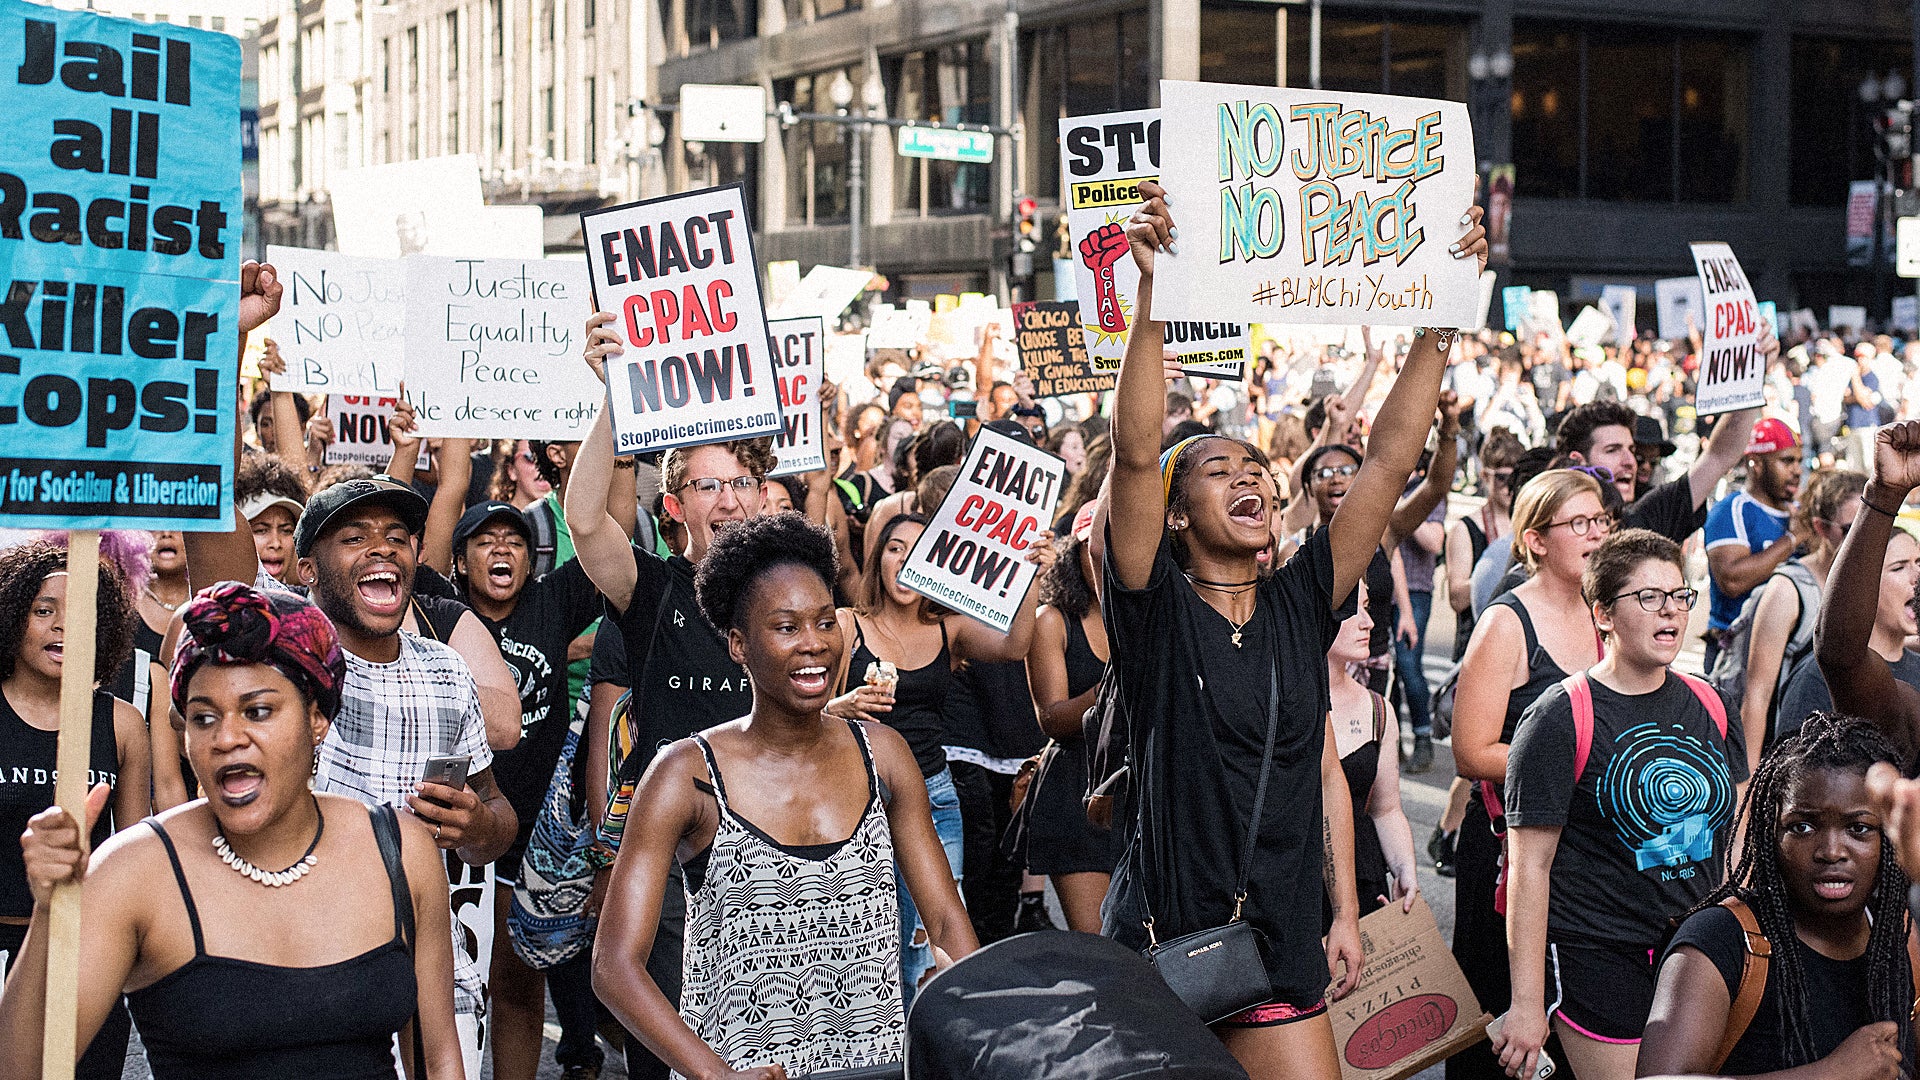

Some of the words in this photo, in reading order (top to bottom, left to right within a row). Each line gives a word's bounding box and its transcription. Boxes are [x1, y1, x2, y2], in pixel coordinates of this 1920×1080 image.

[17, 18, 191, 107] Jail
[50, 107, 160, 179] all
[1066, 118, 1161, 177] ST
[1217, 99, 1285, 183] NO
[1290, 102, 1445, 184] JUSTICE
[1077, 183, 1140, 204] Police
[1219, 181, 1286, 265] NO
[1299, 178, 1426, 268] PEACE
[600, 209, 735, 287] ENACT
[292, 269, 343, 306] No
[448, 260, 568, 300] Justice
[1252, 273, 1433, 311] #BLMChiYouth
[1702, 258, 1746, 294] ENACT
[622, 279, 738, 348] CPAC
[1024, 310, 1070, 330] CHICAGO
[1163, 321, 1242, 345] OUNCIL
[1715, 299, 1756, 340] CPAC
[460, 349, 540, 384] Peace
[770, 331, 816, 369] ACT
[1022, 348, 1064, 368] KILLING
[1068, 347, 1089, 363] THE
[1707, 344, 1756, 386] NOW!
[627, 343, 756, 415] NOW!
[777, 374, 808, 408] AC
[1038, 379, 1053, 396] AN
[1054, 375, 1115, 394] EDUCATION
[1044, 363, 1084, 379] GIVING
[454, 395, 542, 422] deserve
[554, 401, 599, 429] right
[620, 411, 777, 447] StopPoliceCrimes.com
[774, 412, 809, 449] W!
[9, 468, 38, 502] for
[40, 469, 113, 503] Socialism
[115, 472, 130, 504] &
[133, 472, 219, 506] Liberation
[969, 446, 1058, 511] ENACT
[955, 494, 1039, 551] CPAC
[925, 529, 1021, 598] NOW!
[904, 567, 1010, 627] StopPoliceCrimes.com
[500, 637, 553, 679] SOCIETY
[1344, 976, 1422, 1022] PIZZA
